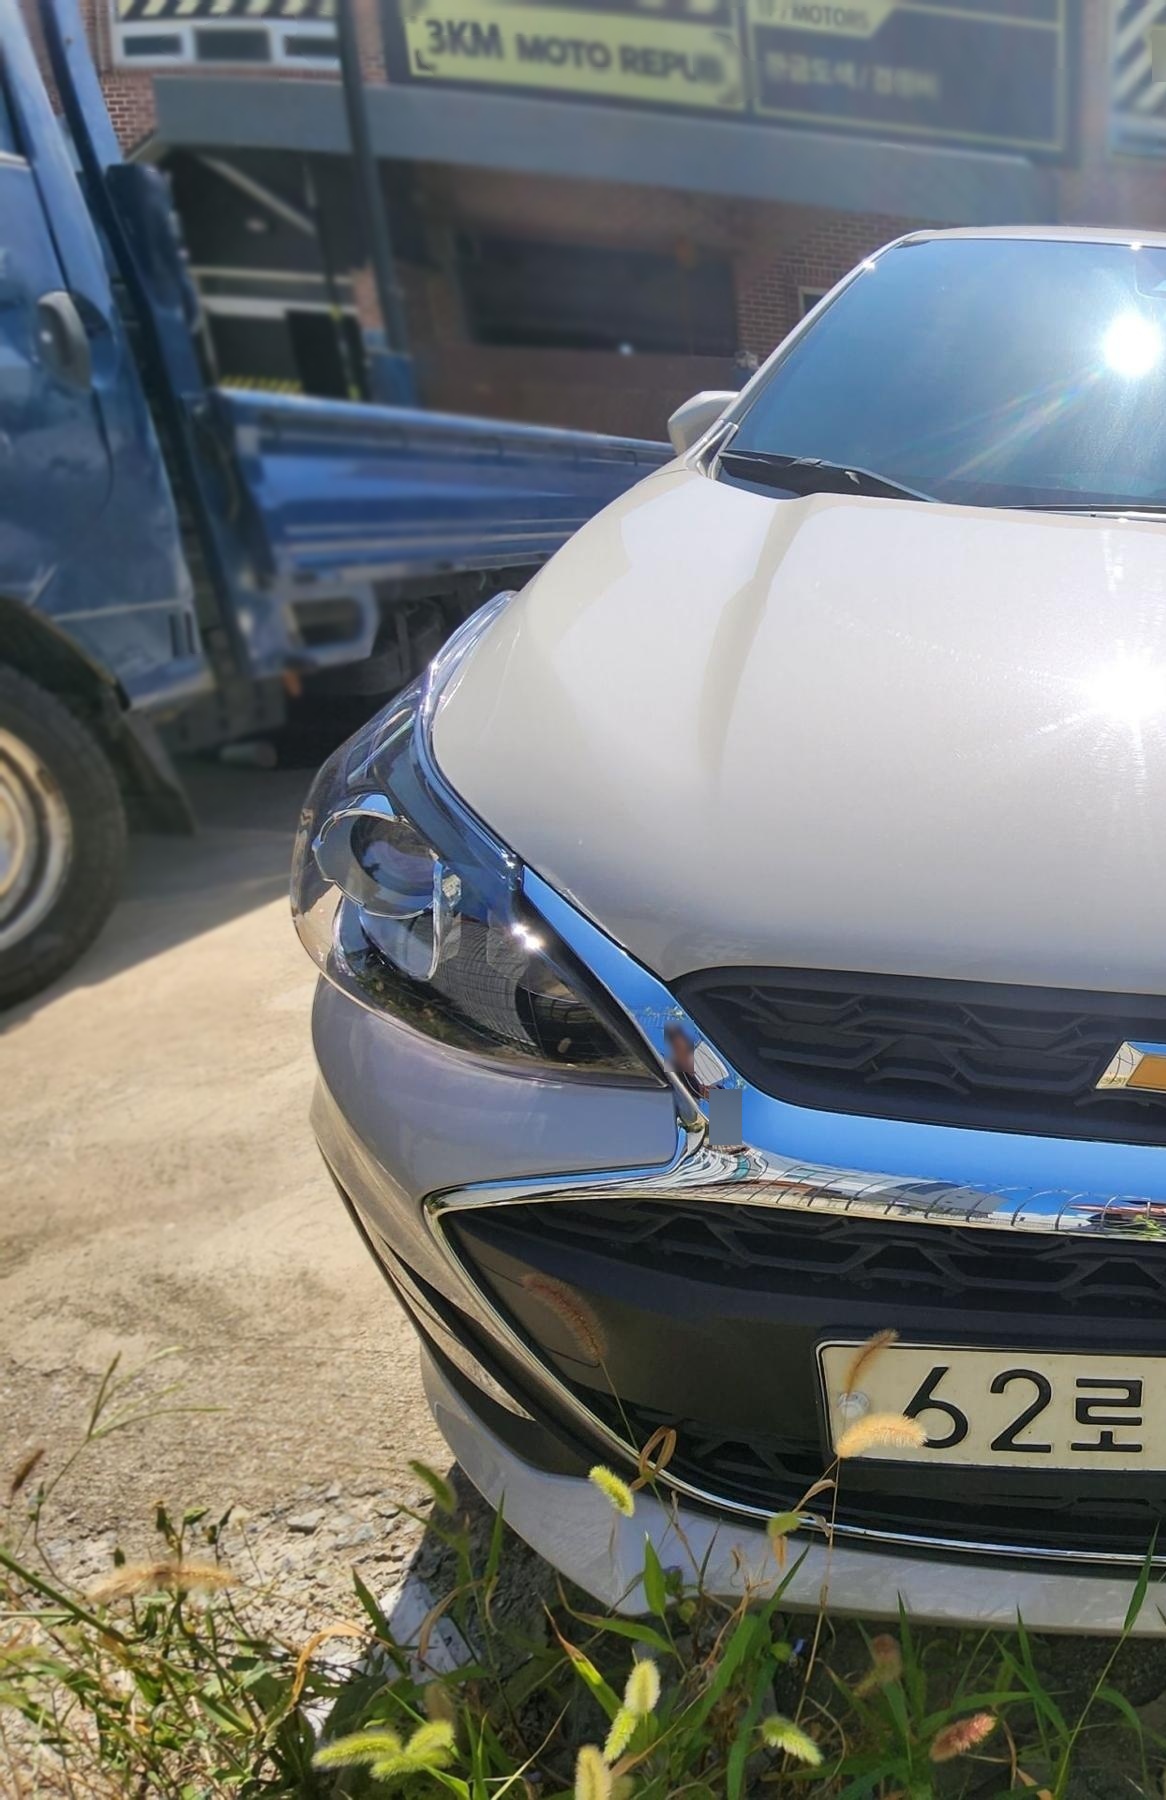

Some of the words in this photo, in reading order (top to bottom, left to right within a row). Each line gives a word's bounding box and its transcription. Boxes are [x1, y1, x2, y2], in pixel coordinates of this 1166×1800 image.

[425, 18, 505, 62] 3KM
[514, 32, 613, 70] MOTO
[902, 1365, 1143, 1454] 62로
